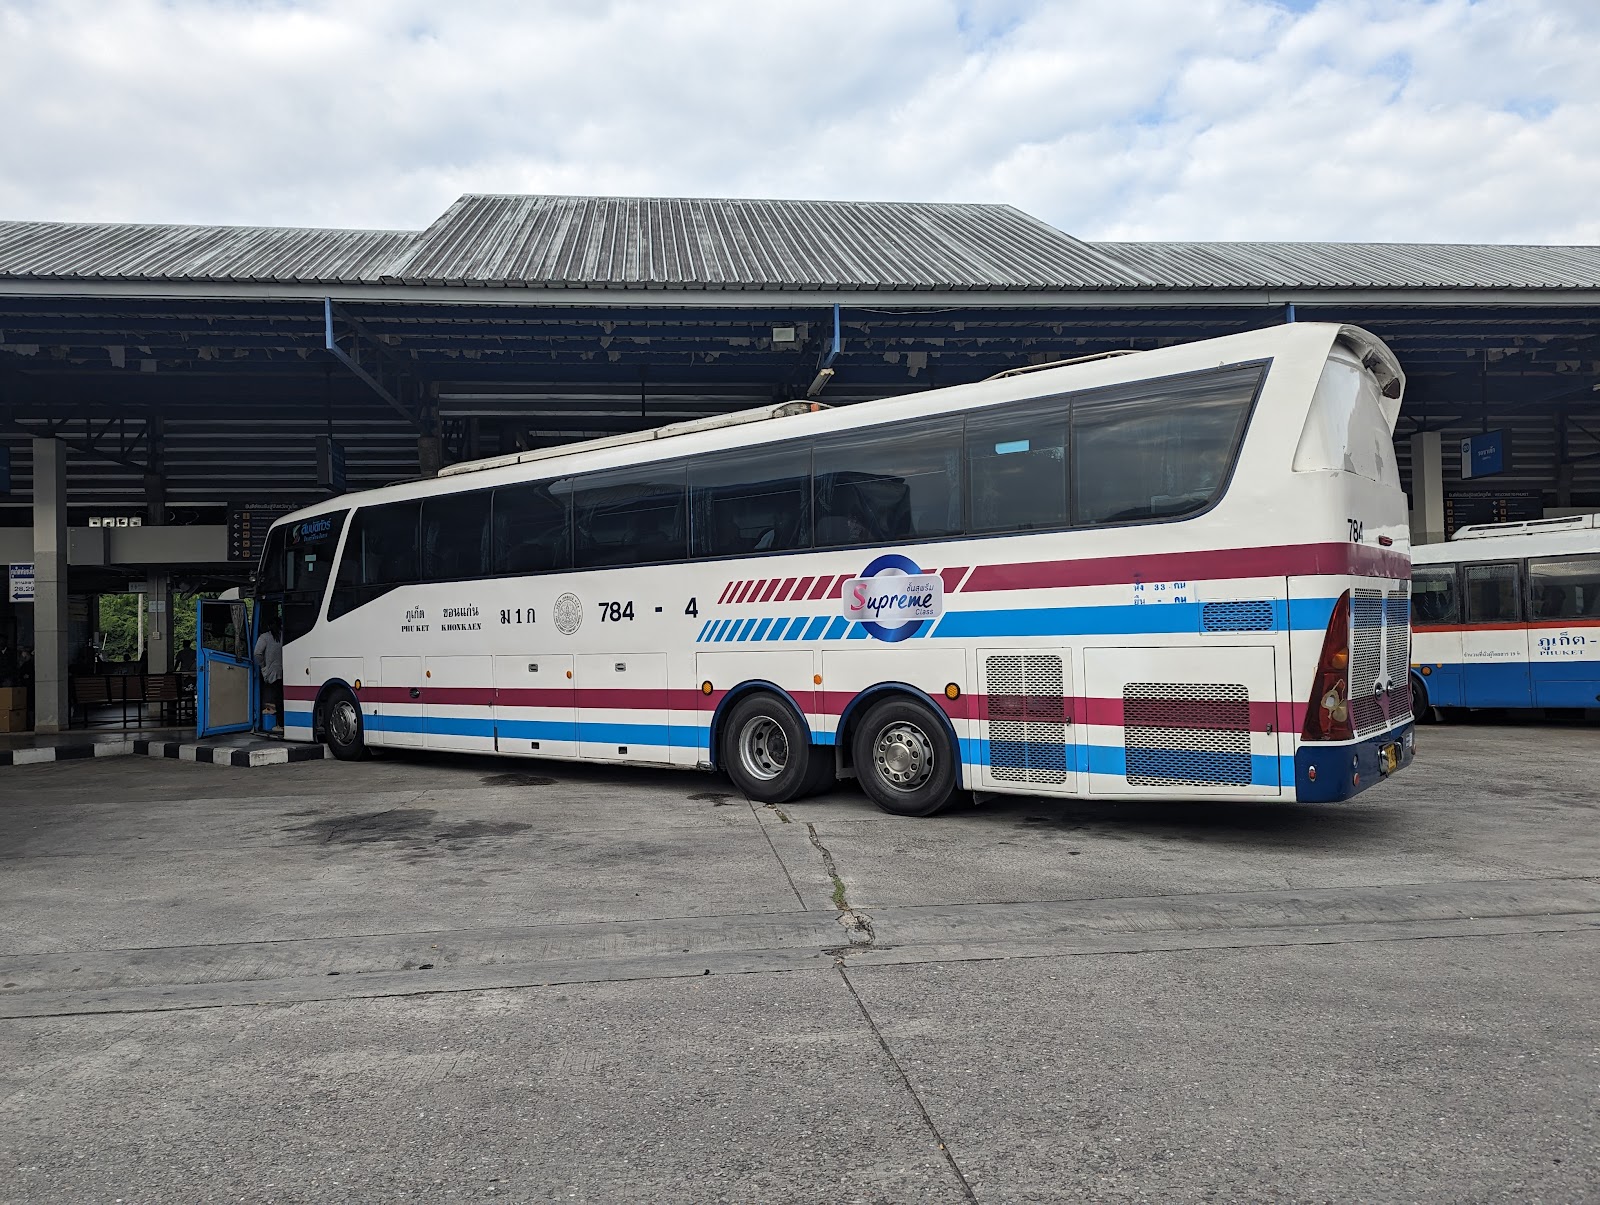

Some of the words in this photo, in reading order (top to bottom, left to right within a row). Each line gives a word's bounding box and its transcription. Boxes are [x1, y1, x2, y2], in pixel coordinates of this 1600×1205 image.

[1347, 518, 1363, 544] 784
[598, 600, 634, 622] 784
[684, 597, 698, 618] 4
[850, 583, 933, 618] Supreme
[405, 605, 425, 622] ภูเก็ต
[443, 603, 479, 618] ขอนแก่น
[915, 608, 934, 616] Class
[441, 622, 481, 631] KHONKAEN
[1538, 631, 1585, 650] ภูเก็ต
